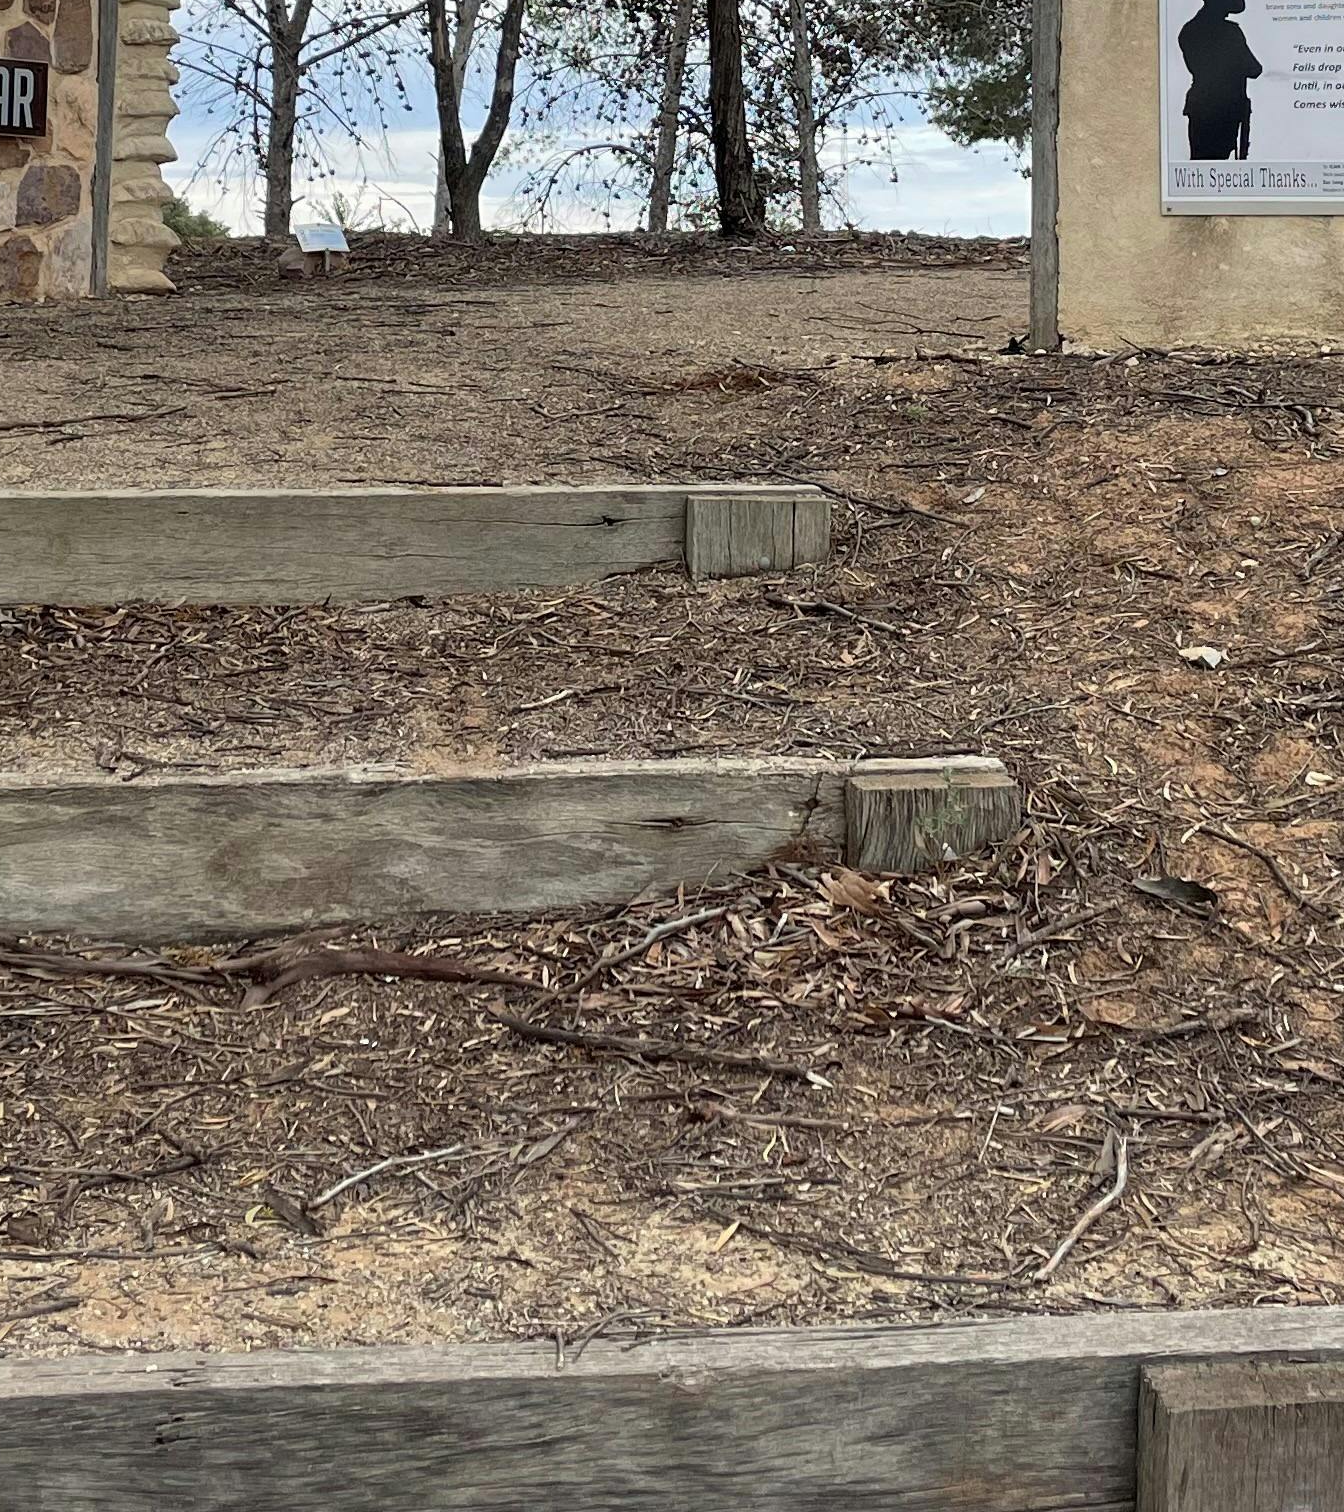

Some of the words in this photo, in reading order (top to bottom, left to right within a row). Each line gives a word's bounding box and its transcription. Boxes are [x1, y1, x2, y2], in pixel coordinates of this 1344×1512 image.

[1324, 43, 1334, 53] in
[1292, 62, 1316, 72] Falls
[1317, 62, 1342, 74] drop
[1322, 80, 1333, 90] in
[1293, 99, 1327, 109] Comes
[1174, 167, 1204, 188] With
[1209, 167, 1254, 192] Special
